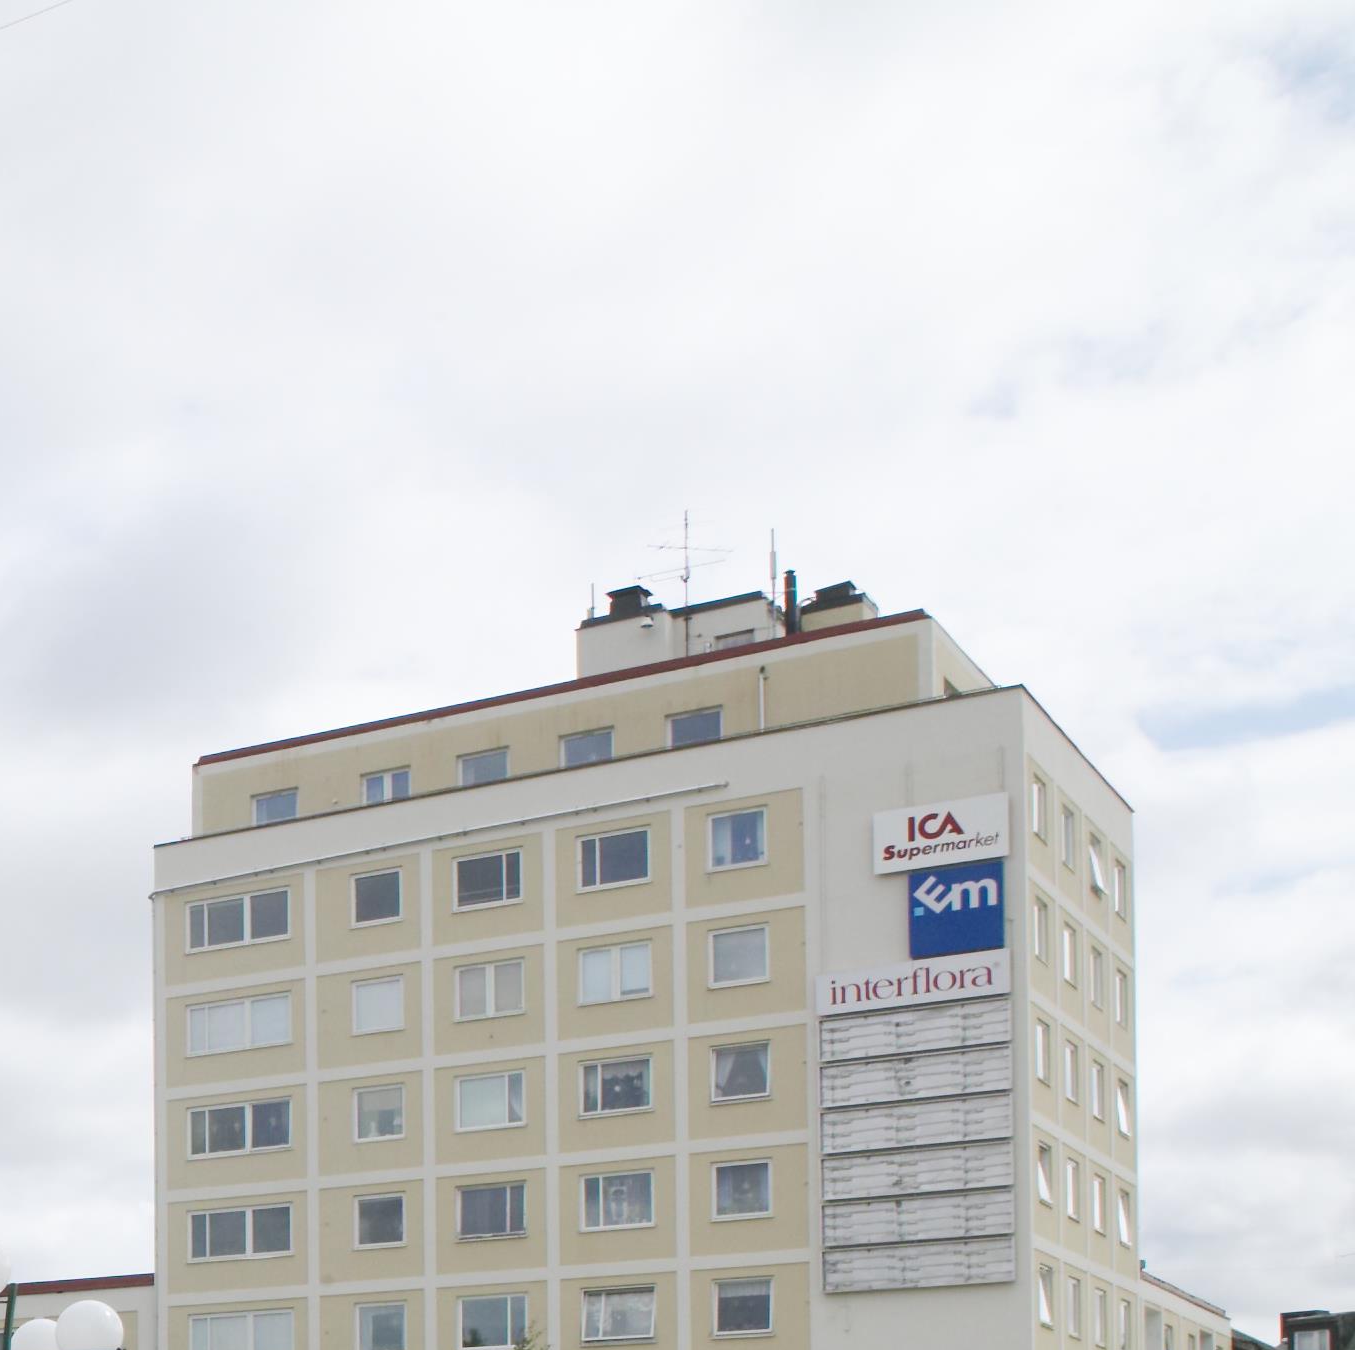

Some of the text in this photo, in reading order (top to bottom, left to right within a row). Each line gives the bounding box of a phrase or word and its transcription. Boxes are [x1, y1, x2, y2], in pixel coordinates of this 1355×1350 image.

[907, 811, 964, 842] ICA
[882, 831, 999, 861] Supermarket
[831, 966, 993, 1004] interflora
